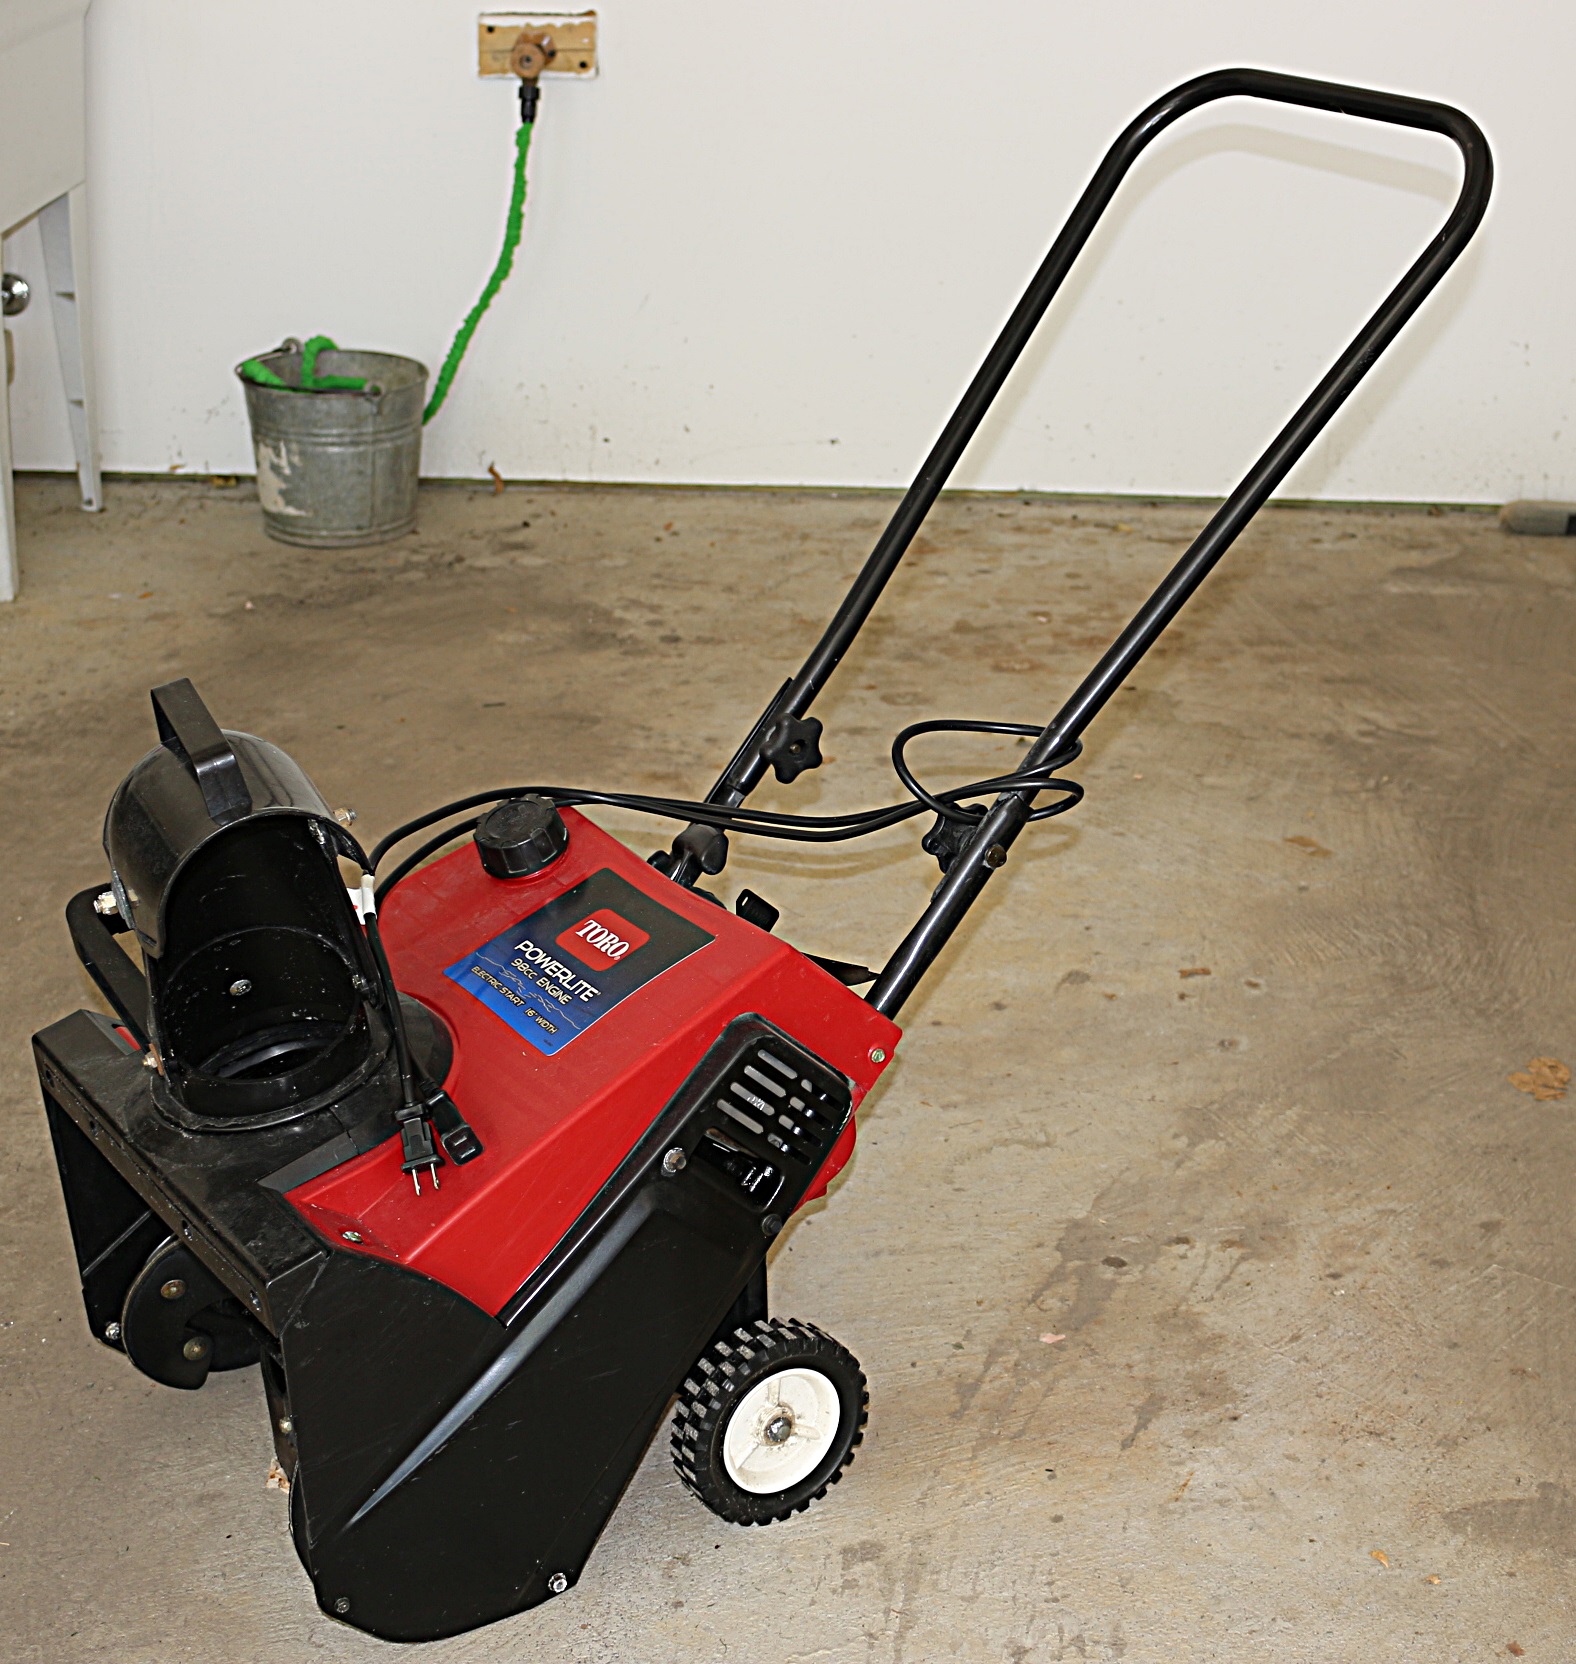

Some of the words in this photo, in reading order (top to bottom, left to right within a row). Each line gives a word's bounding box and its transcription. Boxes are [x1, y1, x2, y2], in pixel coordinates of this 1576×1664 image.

[575, 919, 630, 960] TORO
[514, 940, 599, 1002] POWERLITE
[536, 977, 573, 1005] ENGINE
[471, 966, 502, 994] ELECTRIC
[499, 986, 525, 1007] START
[534, 1015, 558, 1035] WIDTH
